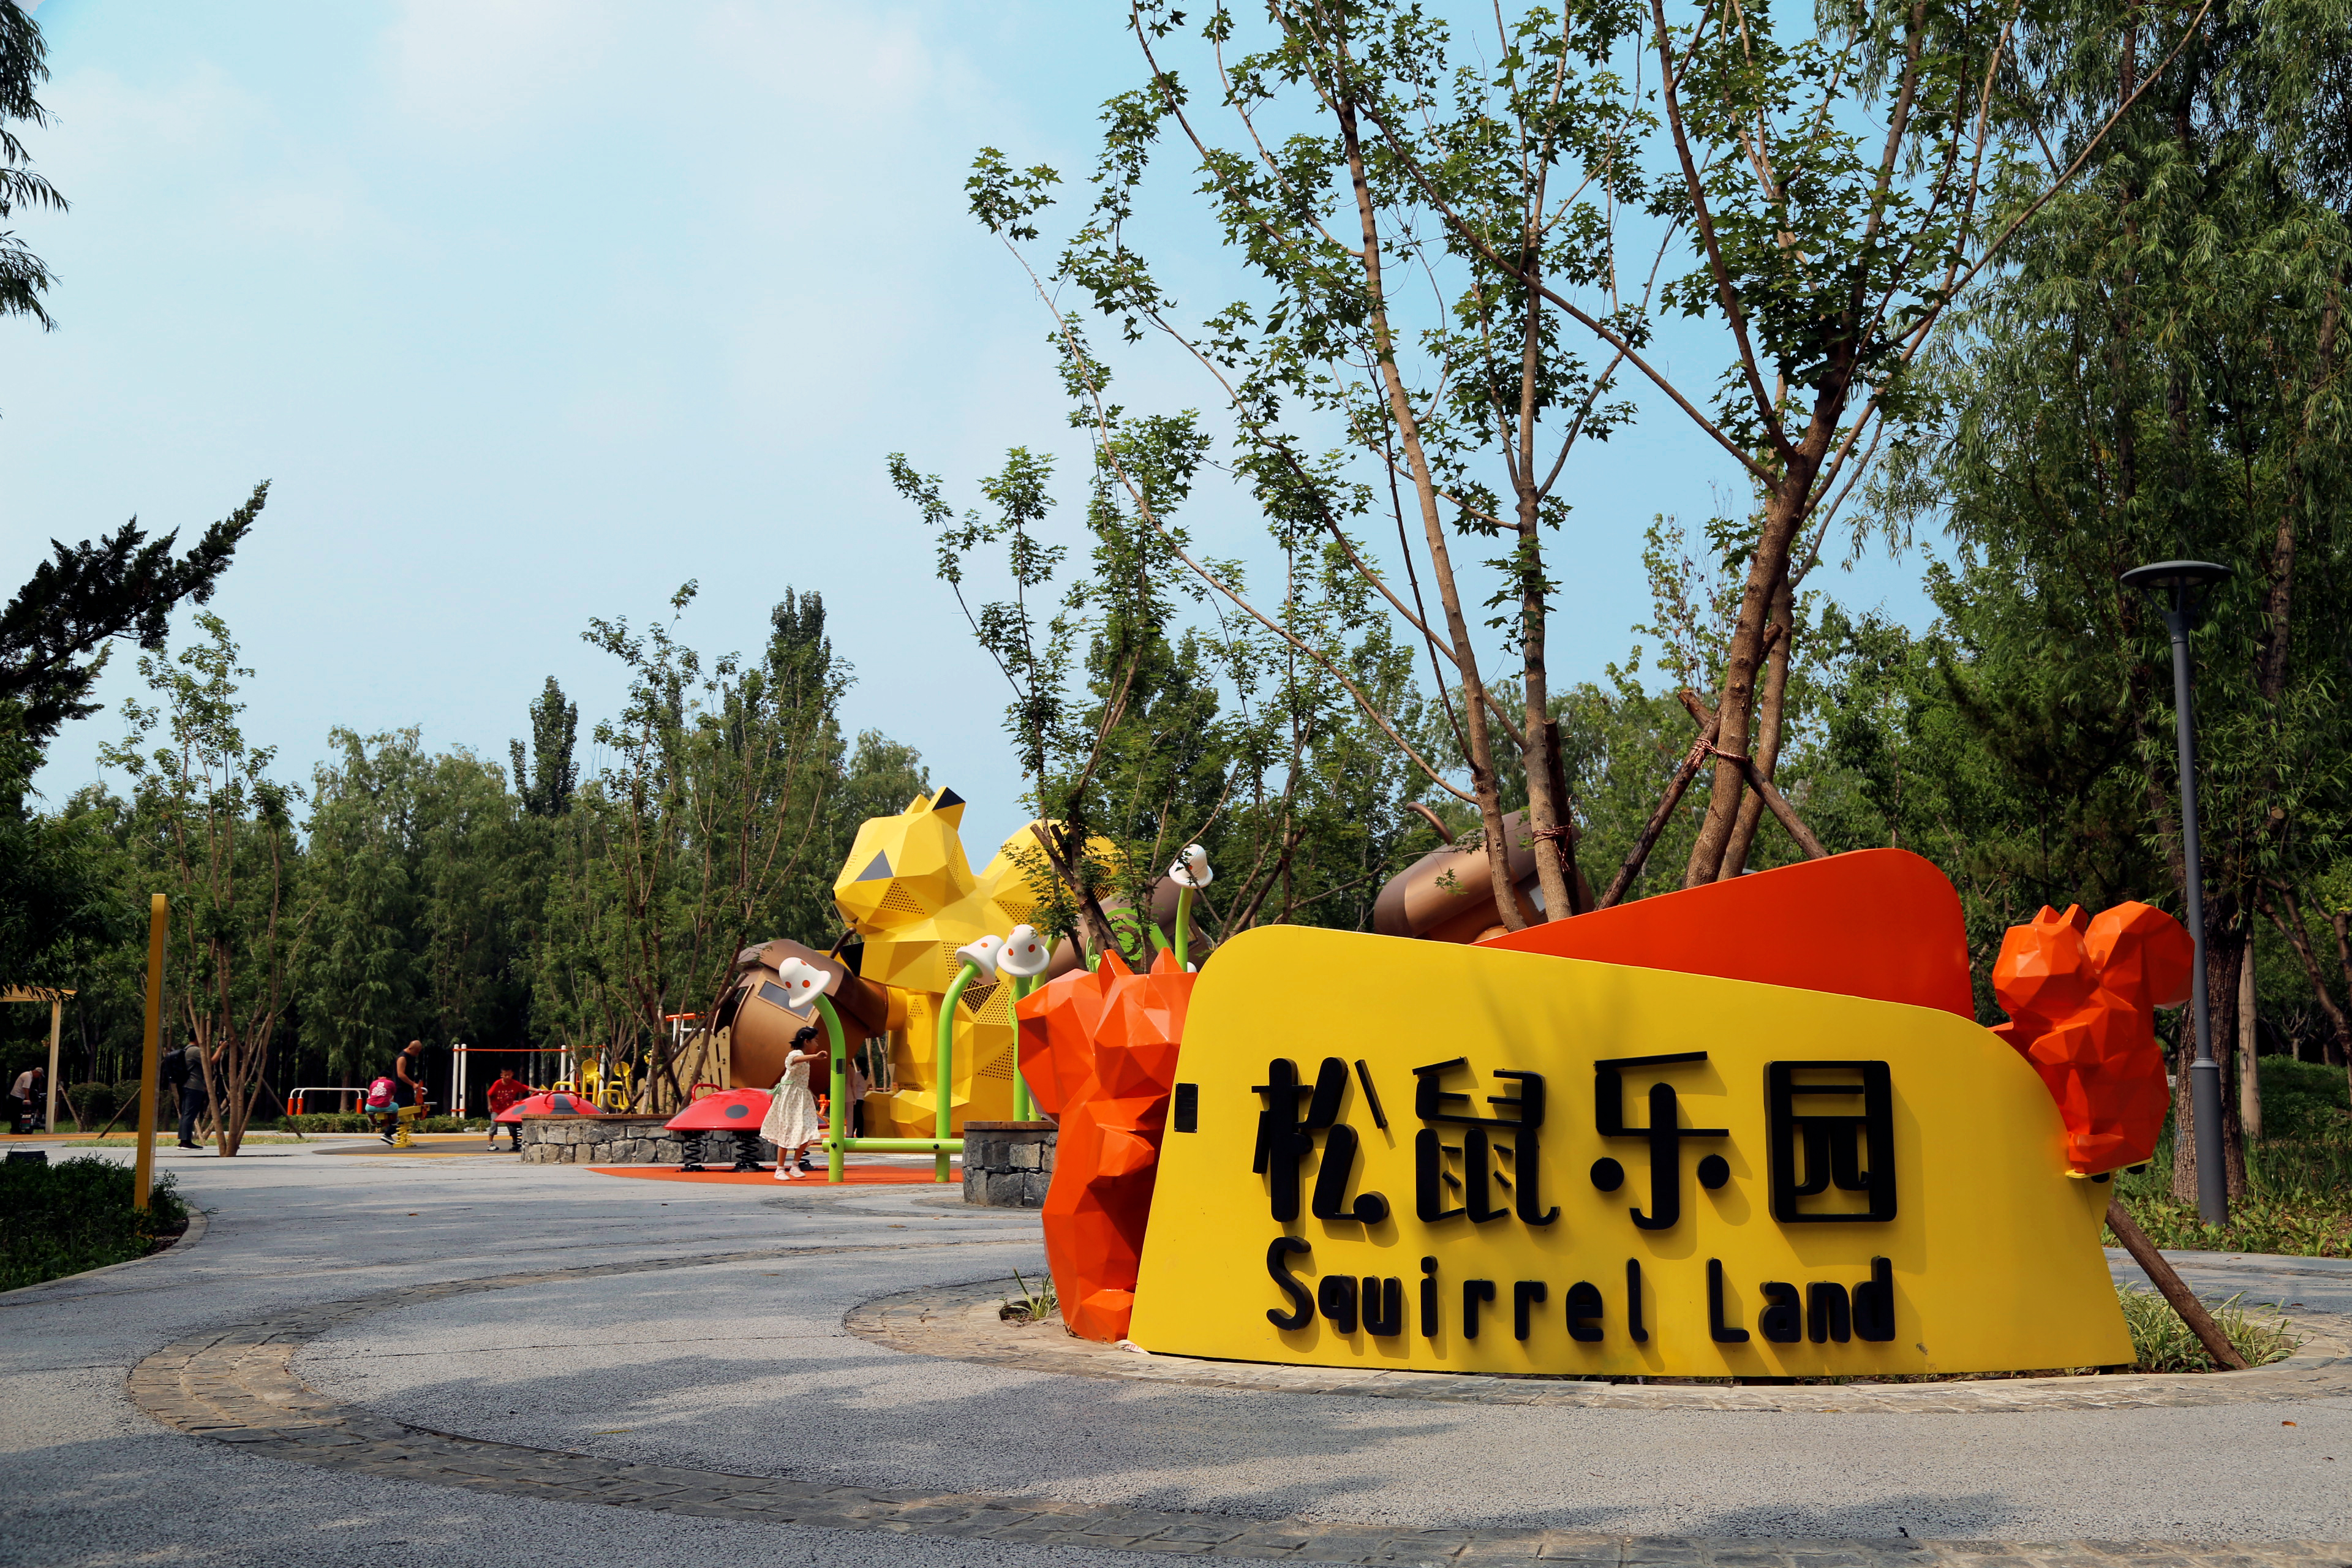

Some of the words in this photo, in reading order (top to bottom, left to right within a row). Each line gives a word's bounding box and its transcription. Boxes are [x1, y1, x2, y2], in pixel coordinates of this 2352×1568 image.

[1251, 1052, 1897, 1230] 松鼠乐园
[1266, 1235, 1649, 1343] Squirrel
[1706, 1256, 1896, 1344] Land
